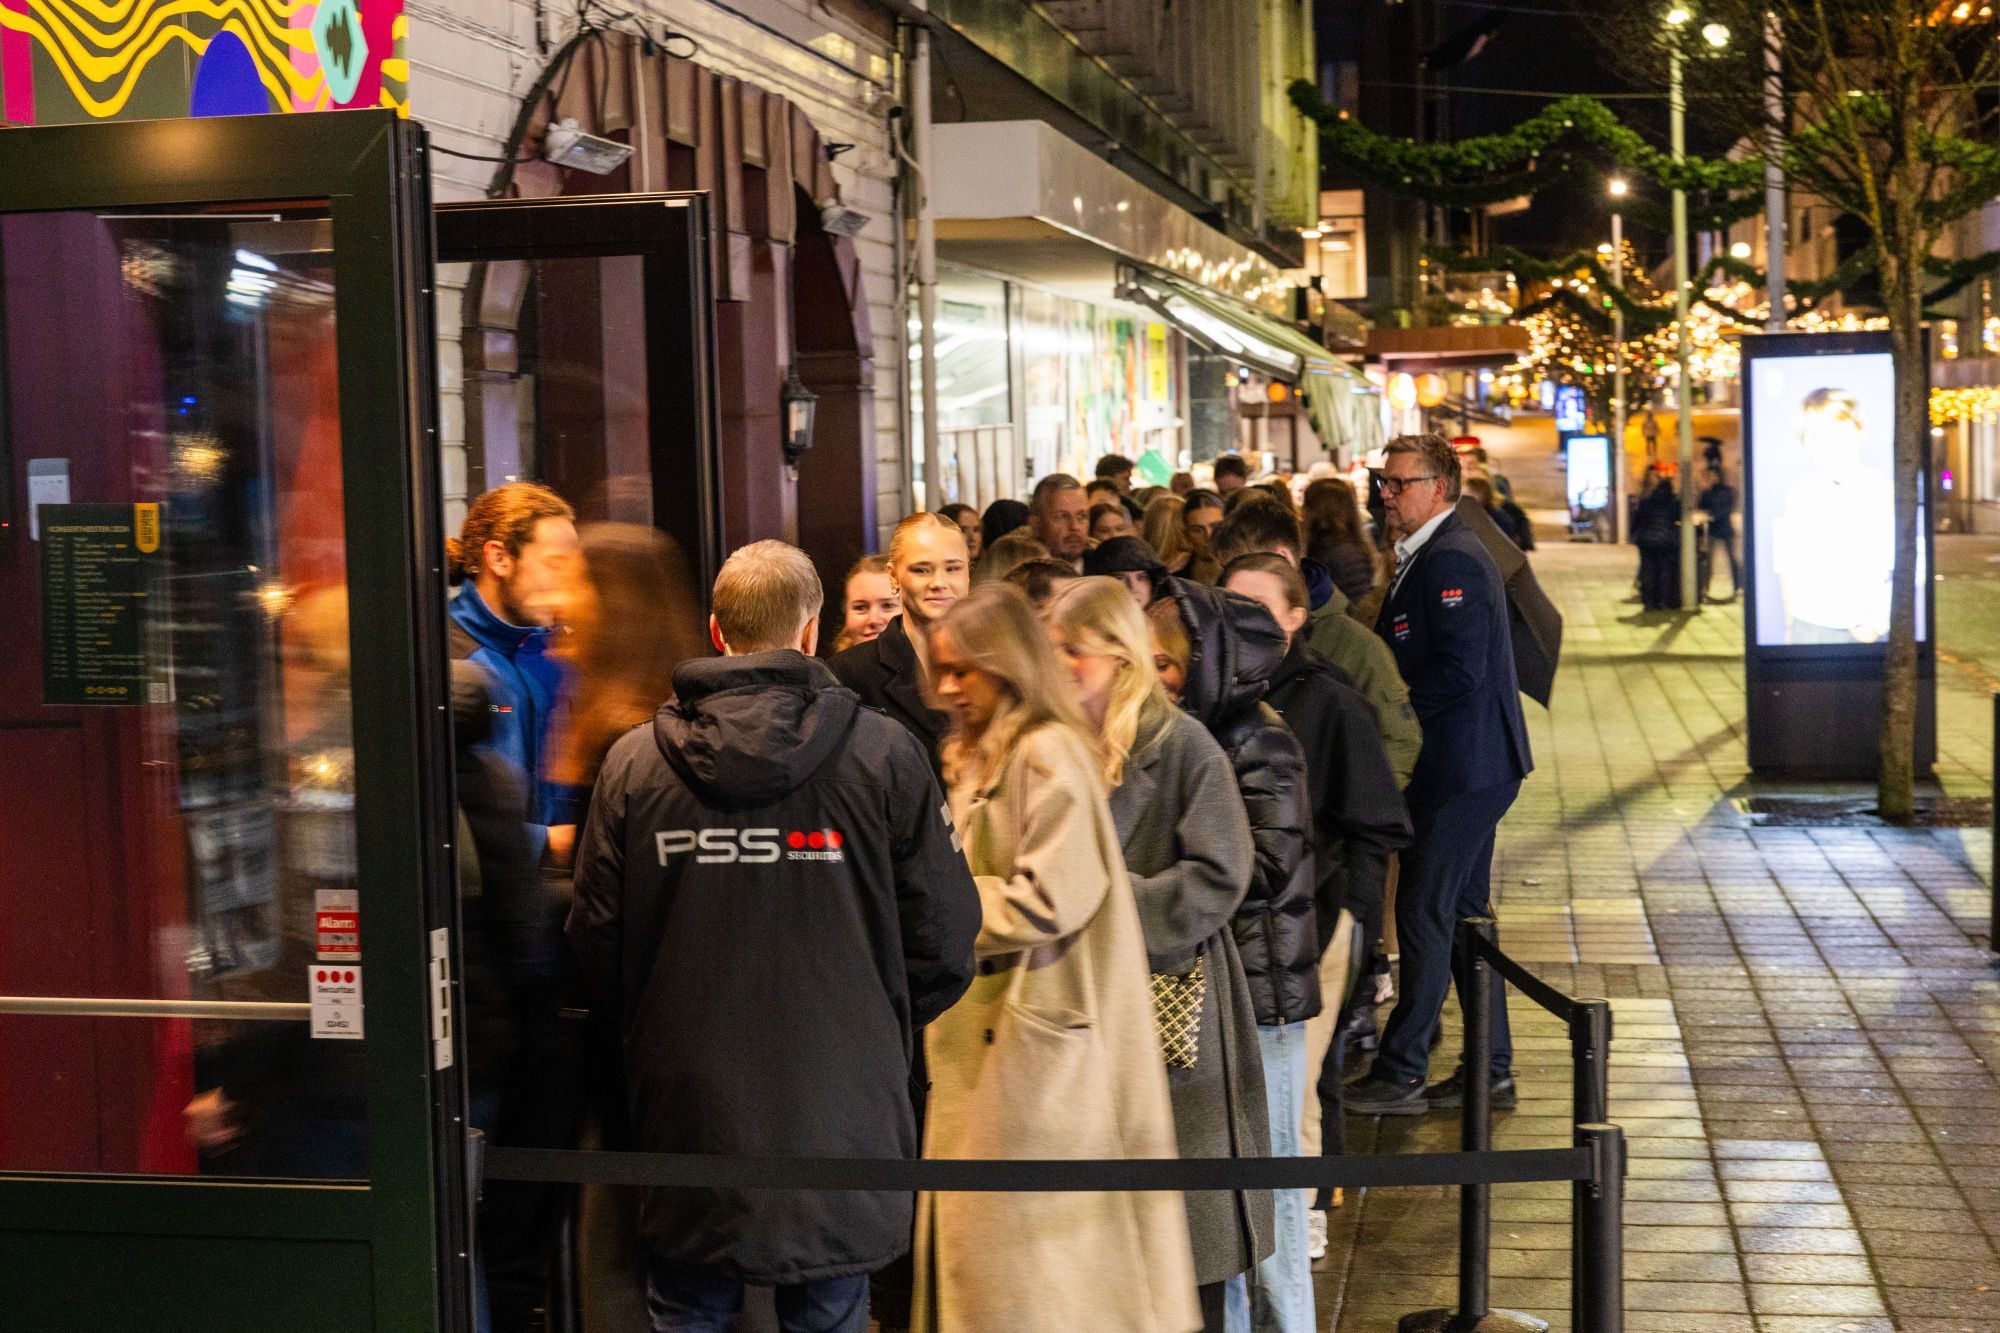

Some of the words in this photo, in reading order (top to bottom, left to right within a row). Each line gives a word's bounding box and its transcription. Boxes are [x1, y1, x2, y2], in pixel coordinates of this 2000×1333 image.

[655, 828, 782, 867] PSS
[787, 851, 842, 861] SECURITAS
[319, 917, 356, 929] Alarm
